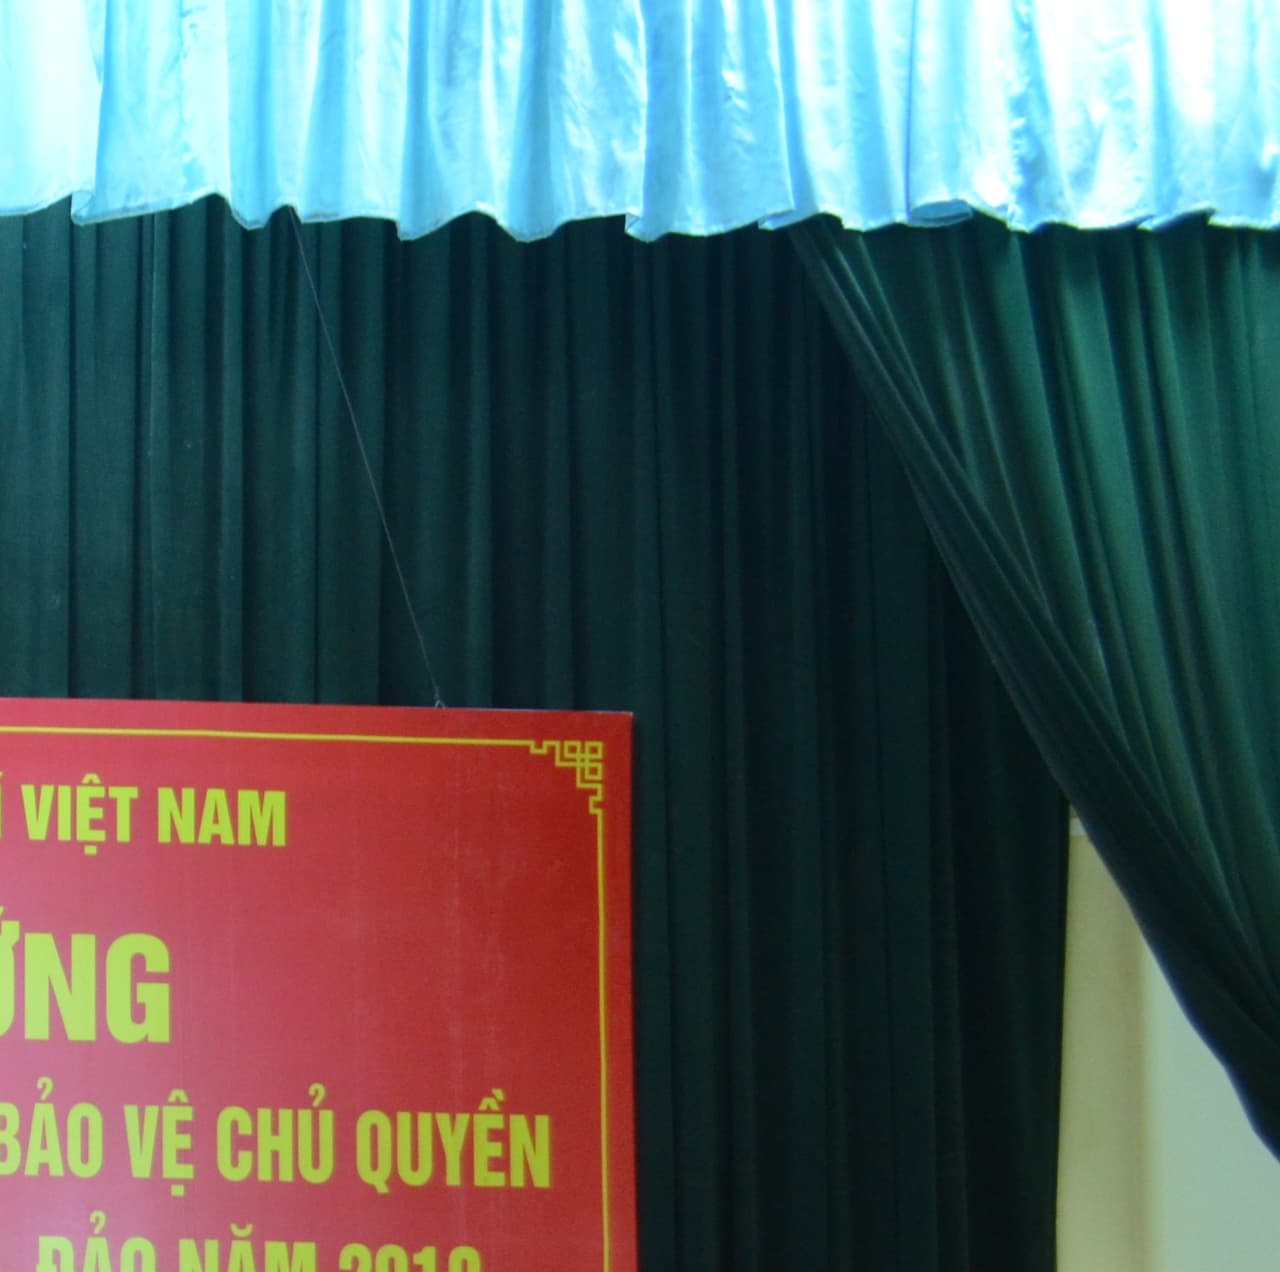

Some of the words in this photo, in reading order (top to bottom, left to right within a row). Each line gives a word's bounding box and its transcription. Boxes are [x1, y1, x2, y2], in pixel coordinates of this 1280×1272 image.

[22, 774, 139, 854] VIỆT
[159, 788, 286, 846] NAM
[125, 1089, 195, 1196] VỆ
[218, 1084, 334, 1183] CHỦ
[358, 1089, 550, 1193] QUYỀN
